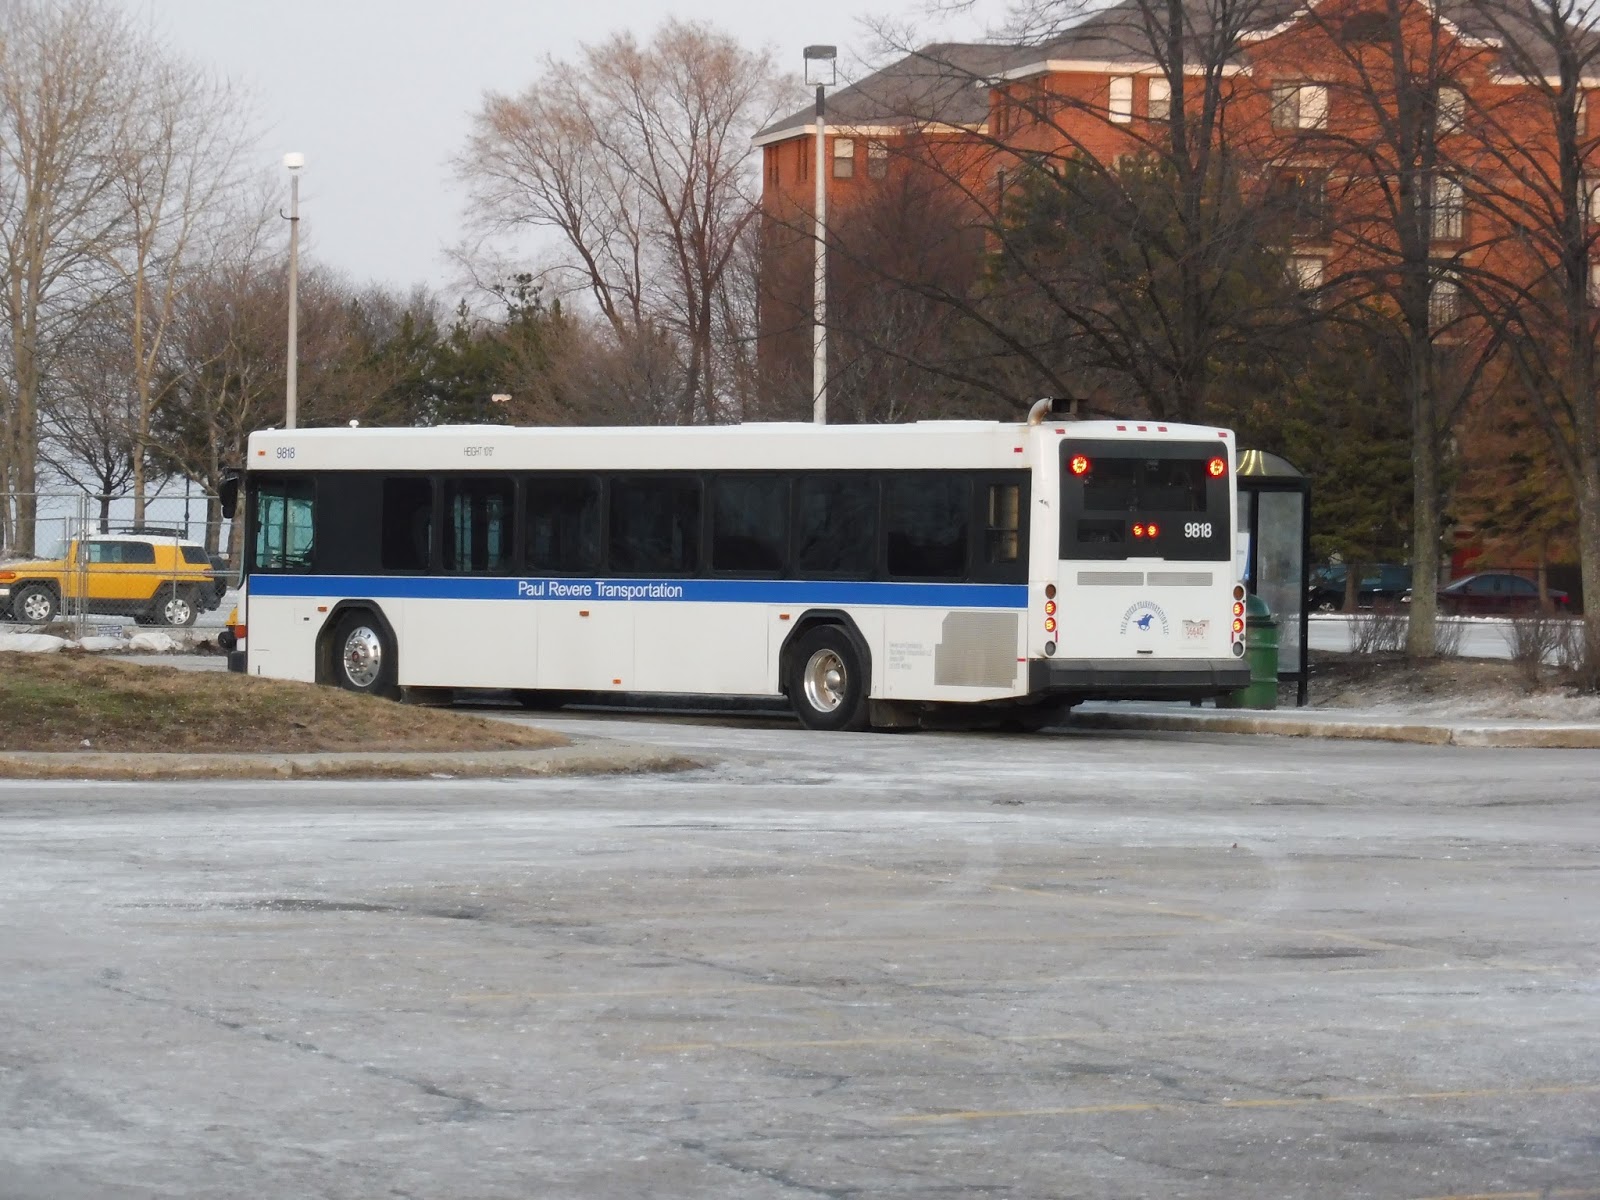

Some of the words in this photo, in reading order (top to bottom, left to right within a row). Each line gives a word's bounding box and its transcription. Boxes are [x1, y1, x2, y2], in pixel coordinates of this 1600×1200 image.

[276, 446, 295, 459] 9818
[463, 446, 482, 456] HEIGHT
[1184, 522, 1212, 538] 9818
[518, 581, 545, 596] Paul
[549, 582, 592, 597] Revere
[595, 582, 683, 600] Transportation
